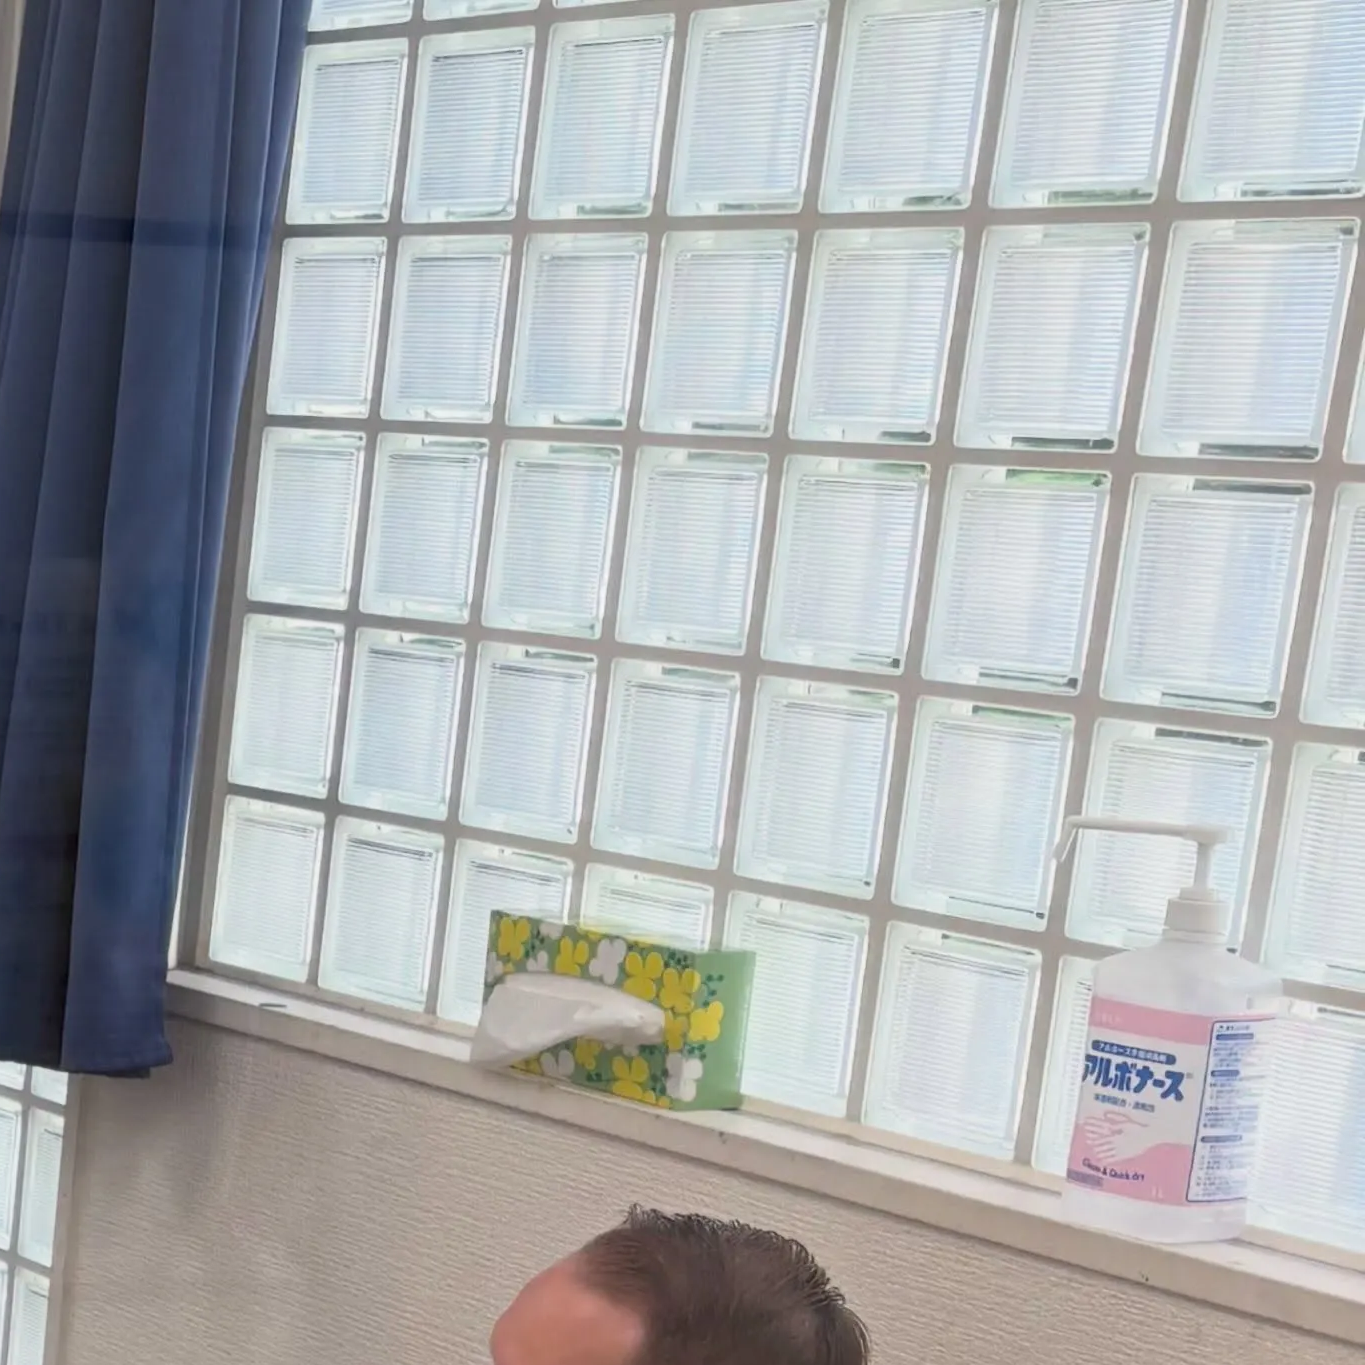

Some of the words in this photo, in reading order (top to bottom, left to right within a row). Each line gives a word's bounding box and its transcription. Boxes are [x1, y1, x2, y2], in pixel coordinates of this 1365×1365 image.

[1082, 1054, 1185, 1102] アルボナース
